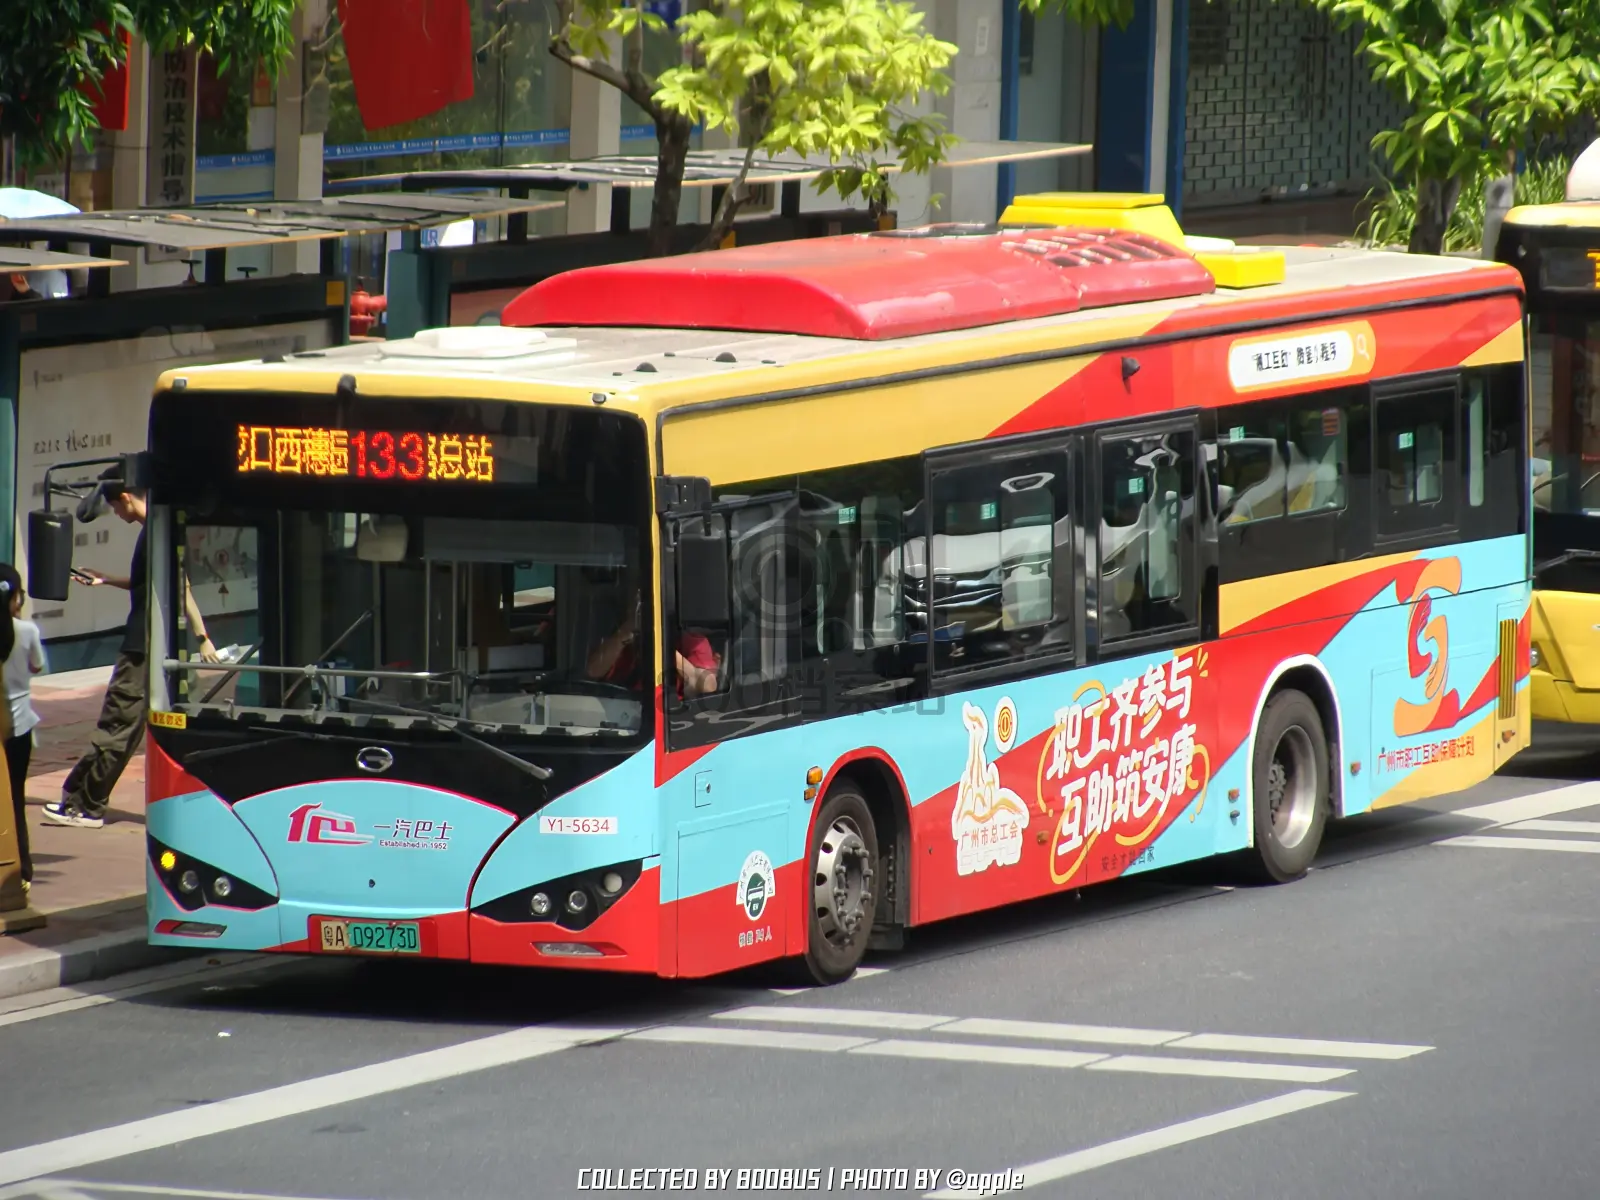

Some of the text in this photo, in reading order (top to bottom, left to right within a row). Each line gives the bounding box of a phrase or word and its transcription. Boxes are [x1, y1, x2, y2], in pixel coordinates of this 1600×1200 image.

[352, 430, 425, 480] 133
[1046, 655, 1194, 780] 职工齐参与
[1057, 724, 1197, 855] 互助筑安康
[373, 819, 453, 840] 一汽巴士
[547, 818, 610, 833] Y1-5634
[960, 822, 1019, 851] 广州市总工会
[379, 839, 421, 849] Established
[430, 842, 447, 850] 1952
